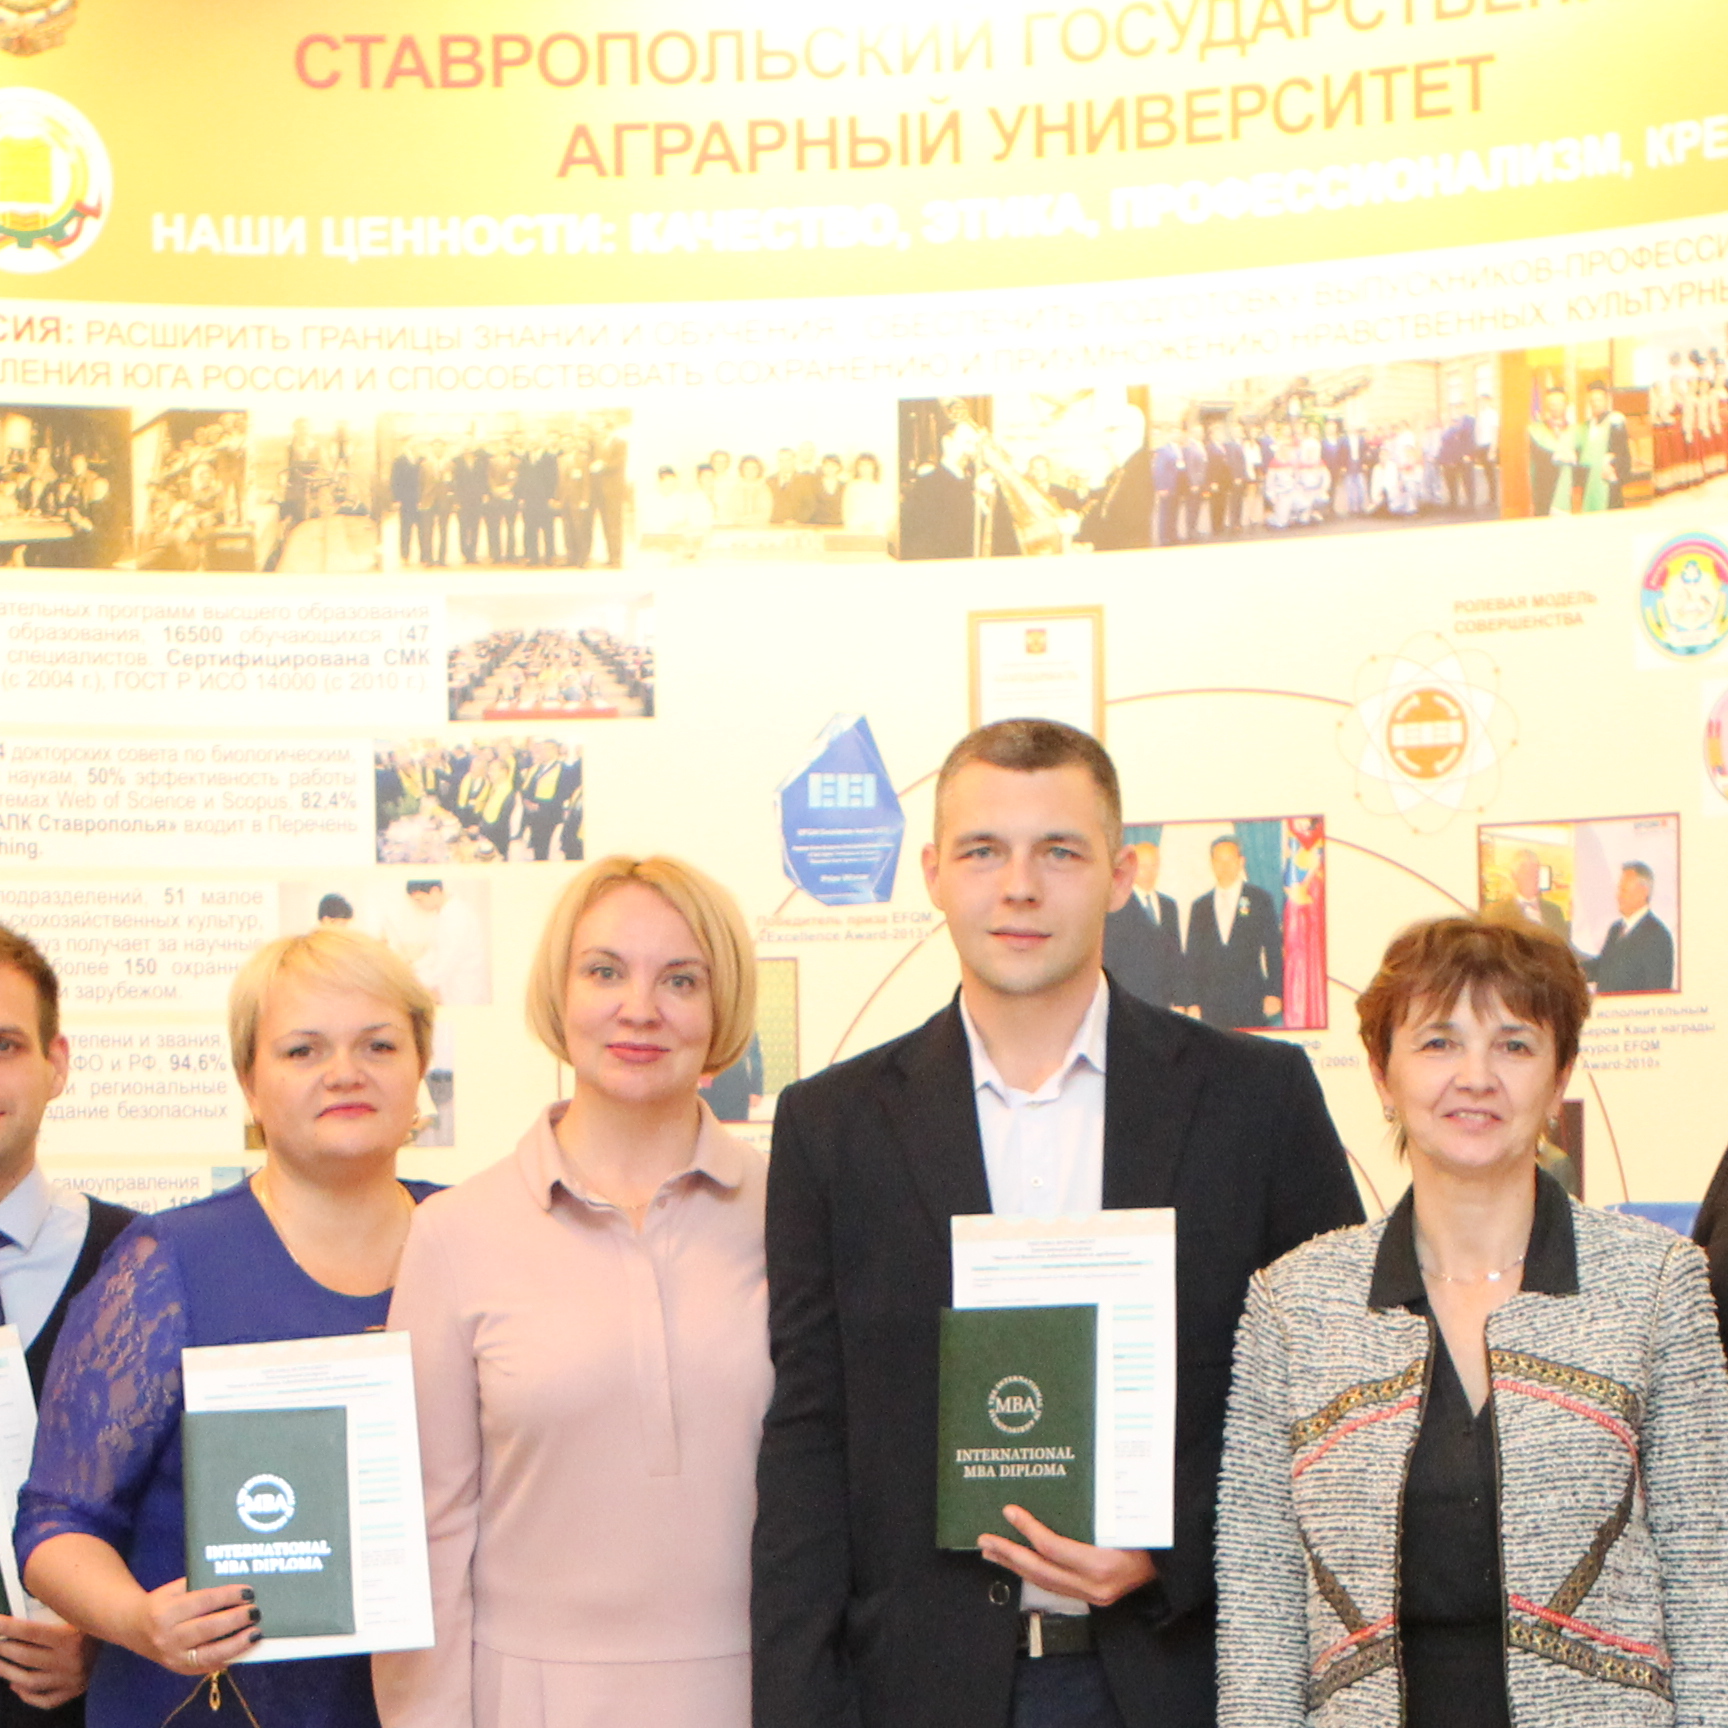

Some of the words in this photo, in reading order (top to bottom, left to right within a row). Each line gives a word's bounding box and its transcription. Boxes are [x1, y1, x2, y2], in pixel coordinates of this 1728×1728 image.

[555, 96, 962, 179] АГРАРНЫЙ
[987, 53, 1496, 162] УНИВЕРСИТЕТ
[150, 211, 306, 257] НАШИ
[320, 212, 617, 265] ЦЕННОСТИ:
[628, 203, 912, 252] КАЧЕСТВО,
[1110, 130, 1633, 229] ПРОФЕССИОНАЛИЗМ,
[85, 320, 292, 350] РАСШИРИТЬ
[301, 325, 462, 354] ГРАНИЦЫ
[621, 323, 642, 347] И
[122, 361, 193, 391] ЮГА
[202, 364, 344, 392] РОССИИ
[354, 365, 378, 392] И
[386, 361, 706, 392] СПОСОБСТВОВАТЬ
[1454, 595, 1527, 613] РОЛЕВАЯ
[1532, 590, 1597, 608] МОДЕЛЬ
[1454, 612, 1584, 634] СОВЕРШЕНСТВА
[162, 626, 225, 644] 16500
[165, 649, 372, 672] Сертифицирована
[86, 766, 127, 786] 50%
[37, 815, 179, 836] Ставрополья»
[162, 887, 186, 908] 51
[124, 958, 158, 977] 150
[1623, 1040, 1660, 1050] EFQM
[169, 1053, 226, 1073] 94,6%
[995, 1396, 1036, 1414] MBA
[956, 1446, 1075, 1462] INTERNATIONAL
[963, 1464, 997, 1478] MBA
[999, 1463, 1068, 1478] DIPLOMA
[244, 1493, 288, 1514] MBA
[204, 1540, 332, 1561] INTERNATIONAL
[214, 1559, 250, 1576] MBA
[252, 1556, 324, 1574] DIPLOMA
